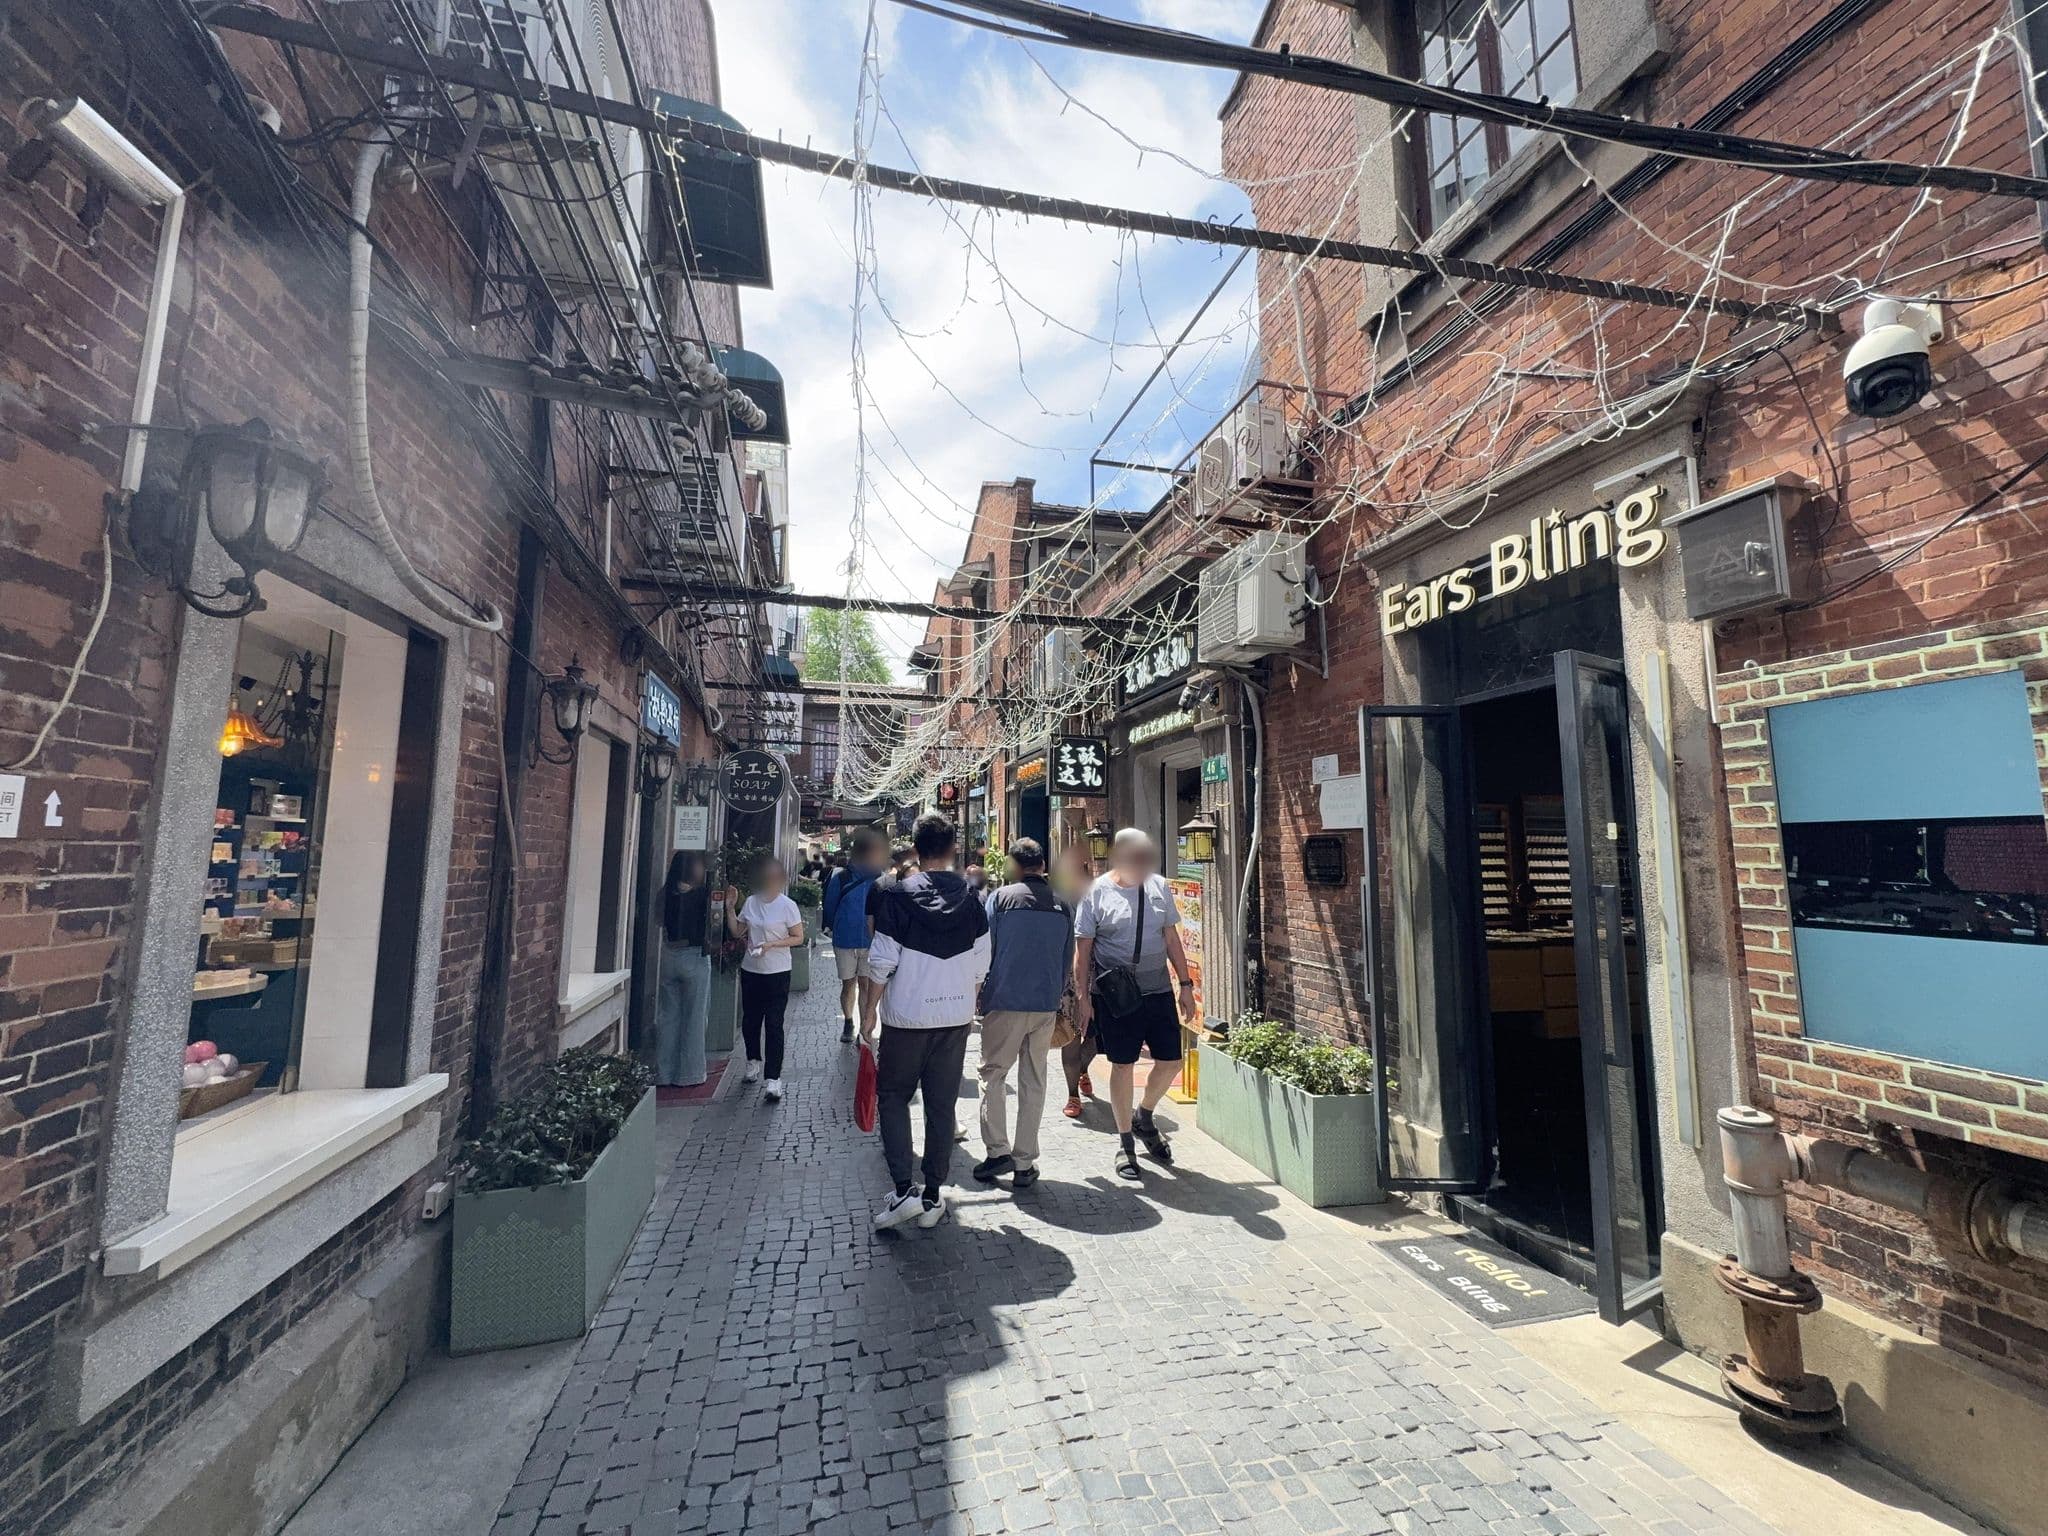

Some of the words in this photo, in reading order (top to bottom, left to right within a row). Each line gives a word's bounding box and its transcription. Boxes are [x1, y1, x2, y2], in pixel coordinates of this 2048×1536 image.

[1382, 567, 1477, 637] Ears
[1490, 483, 1669, 596] Bling
[725, 759, 780, 778] 手工皂
[733, 779, 771, 790] SOAP
[1206, 760, 1216, 775] 46
[1400, 1245, 1446, 1273] Ears
[1446, 1275, 1511, 1314] Bling
[1453, 1248, 1549, 1298] Hello!
